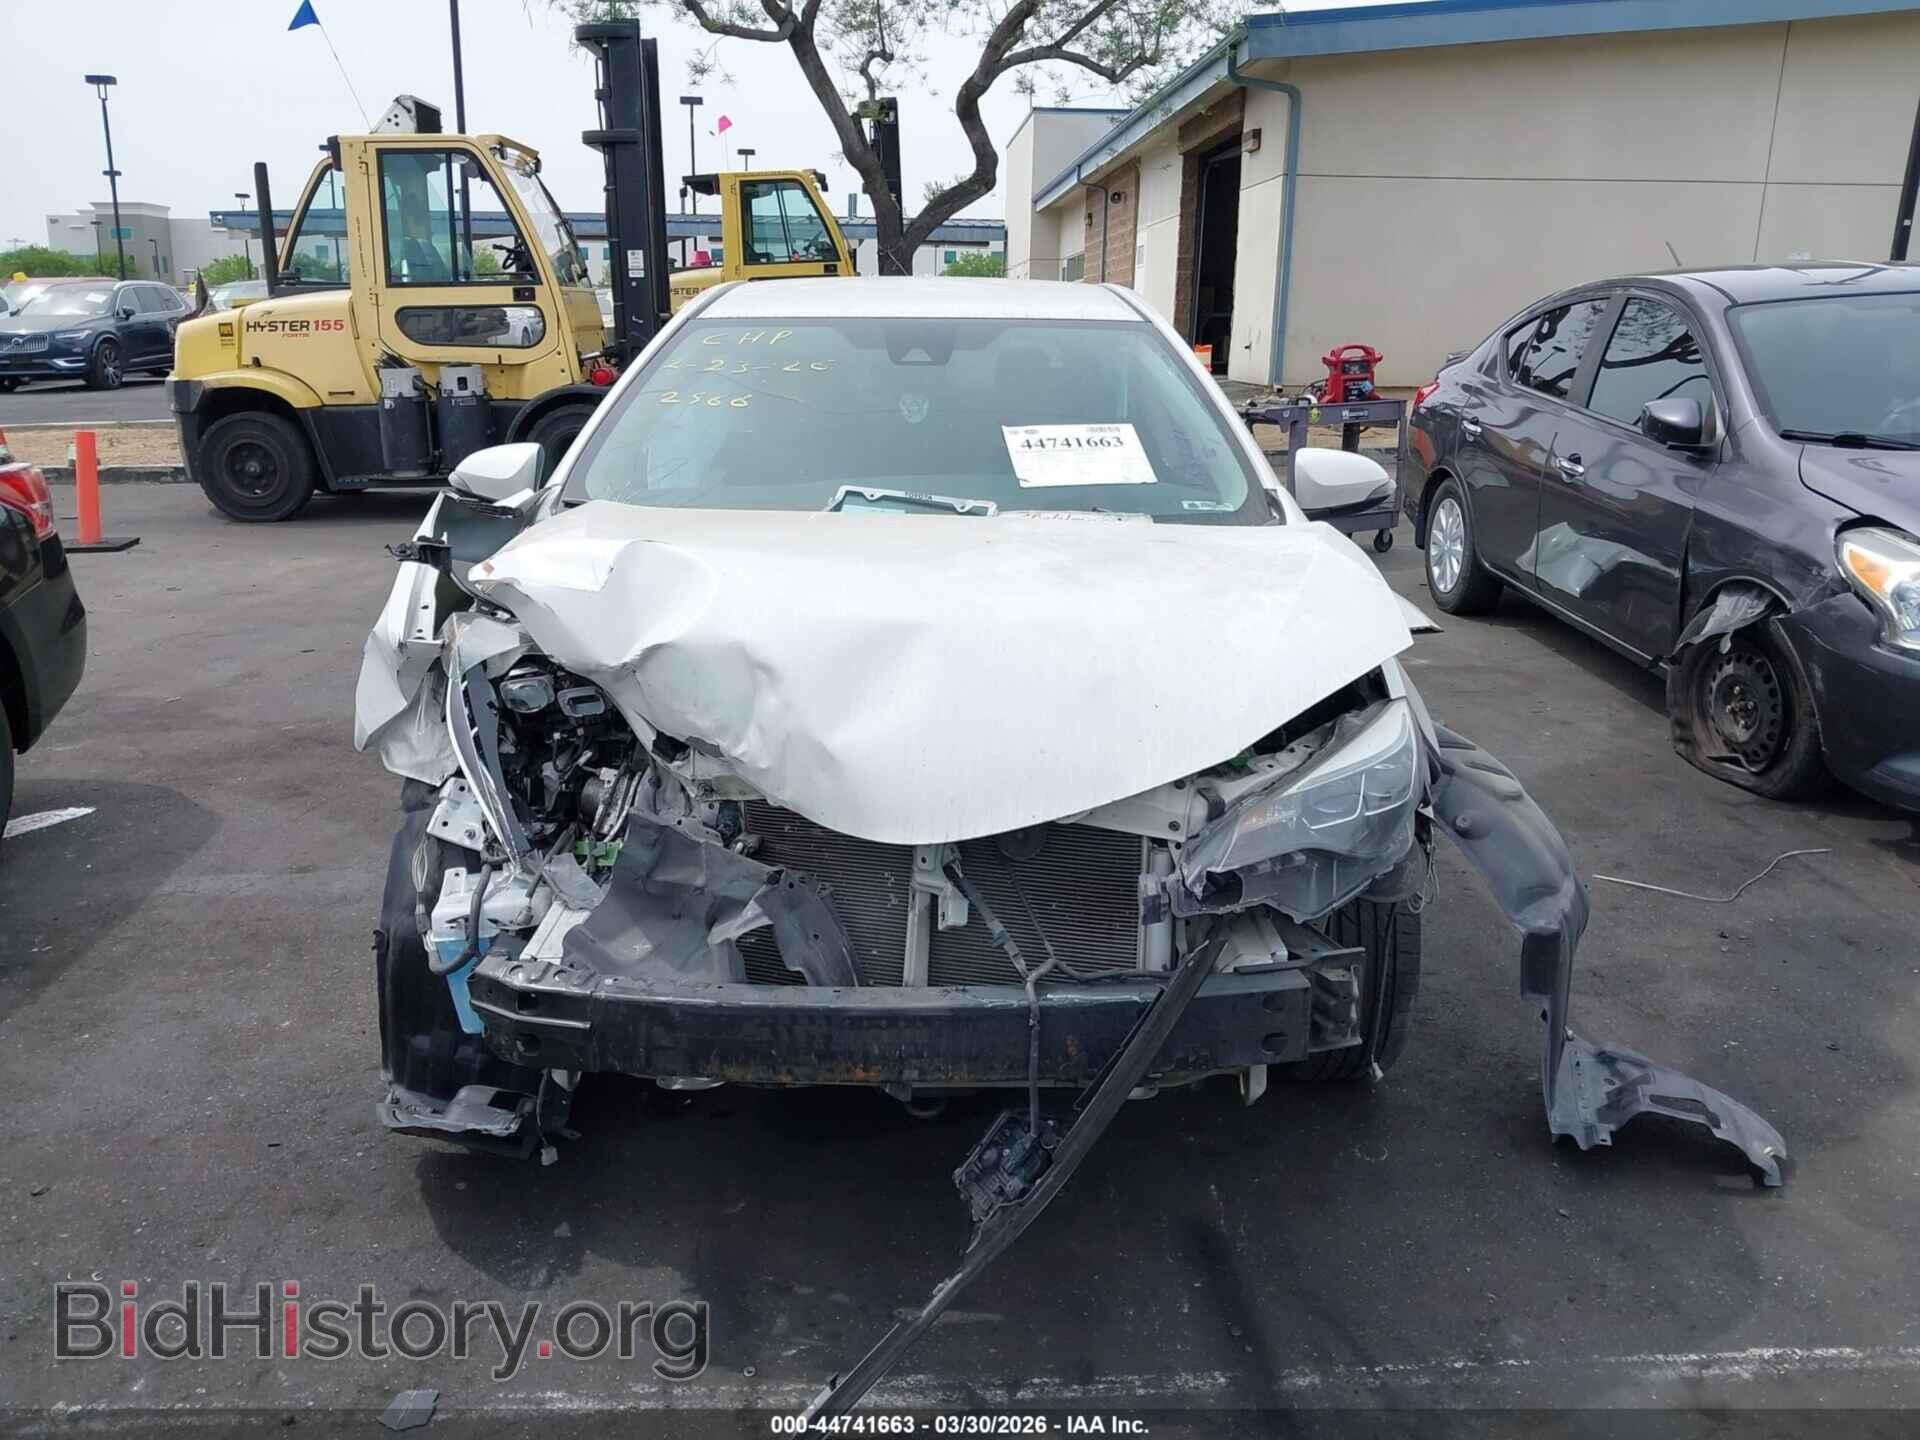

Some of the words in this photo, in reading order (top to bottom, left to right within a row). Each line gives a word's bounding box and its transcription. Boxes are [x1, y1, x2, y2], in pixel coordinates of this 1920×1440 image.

[245, 320, 311, 332] HYSTER
[313, 319, 345, 331] 155
[1019, 435, 1125, 451] 44741663
